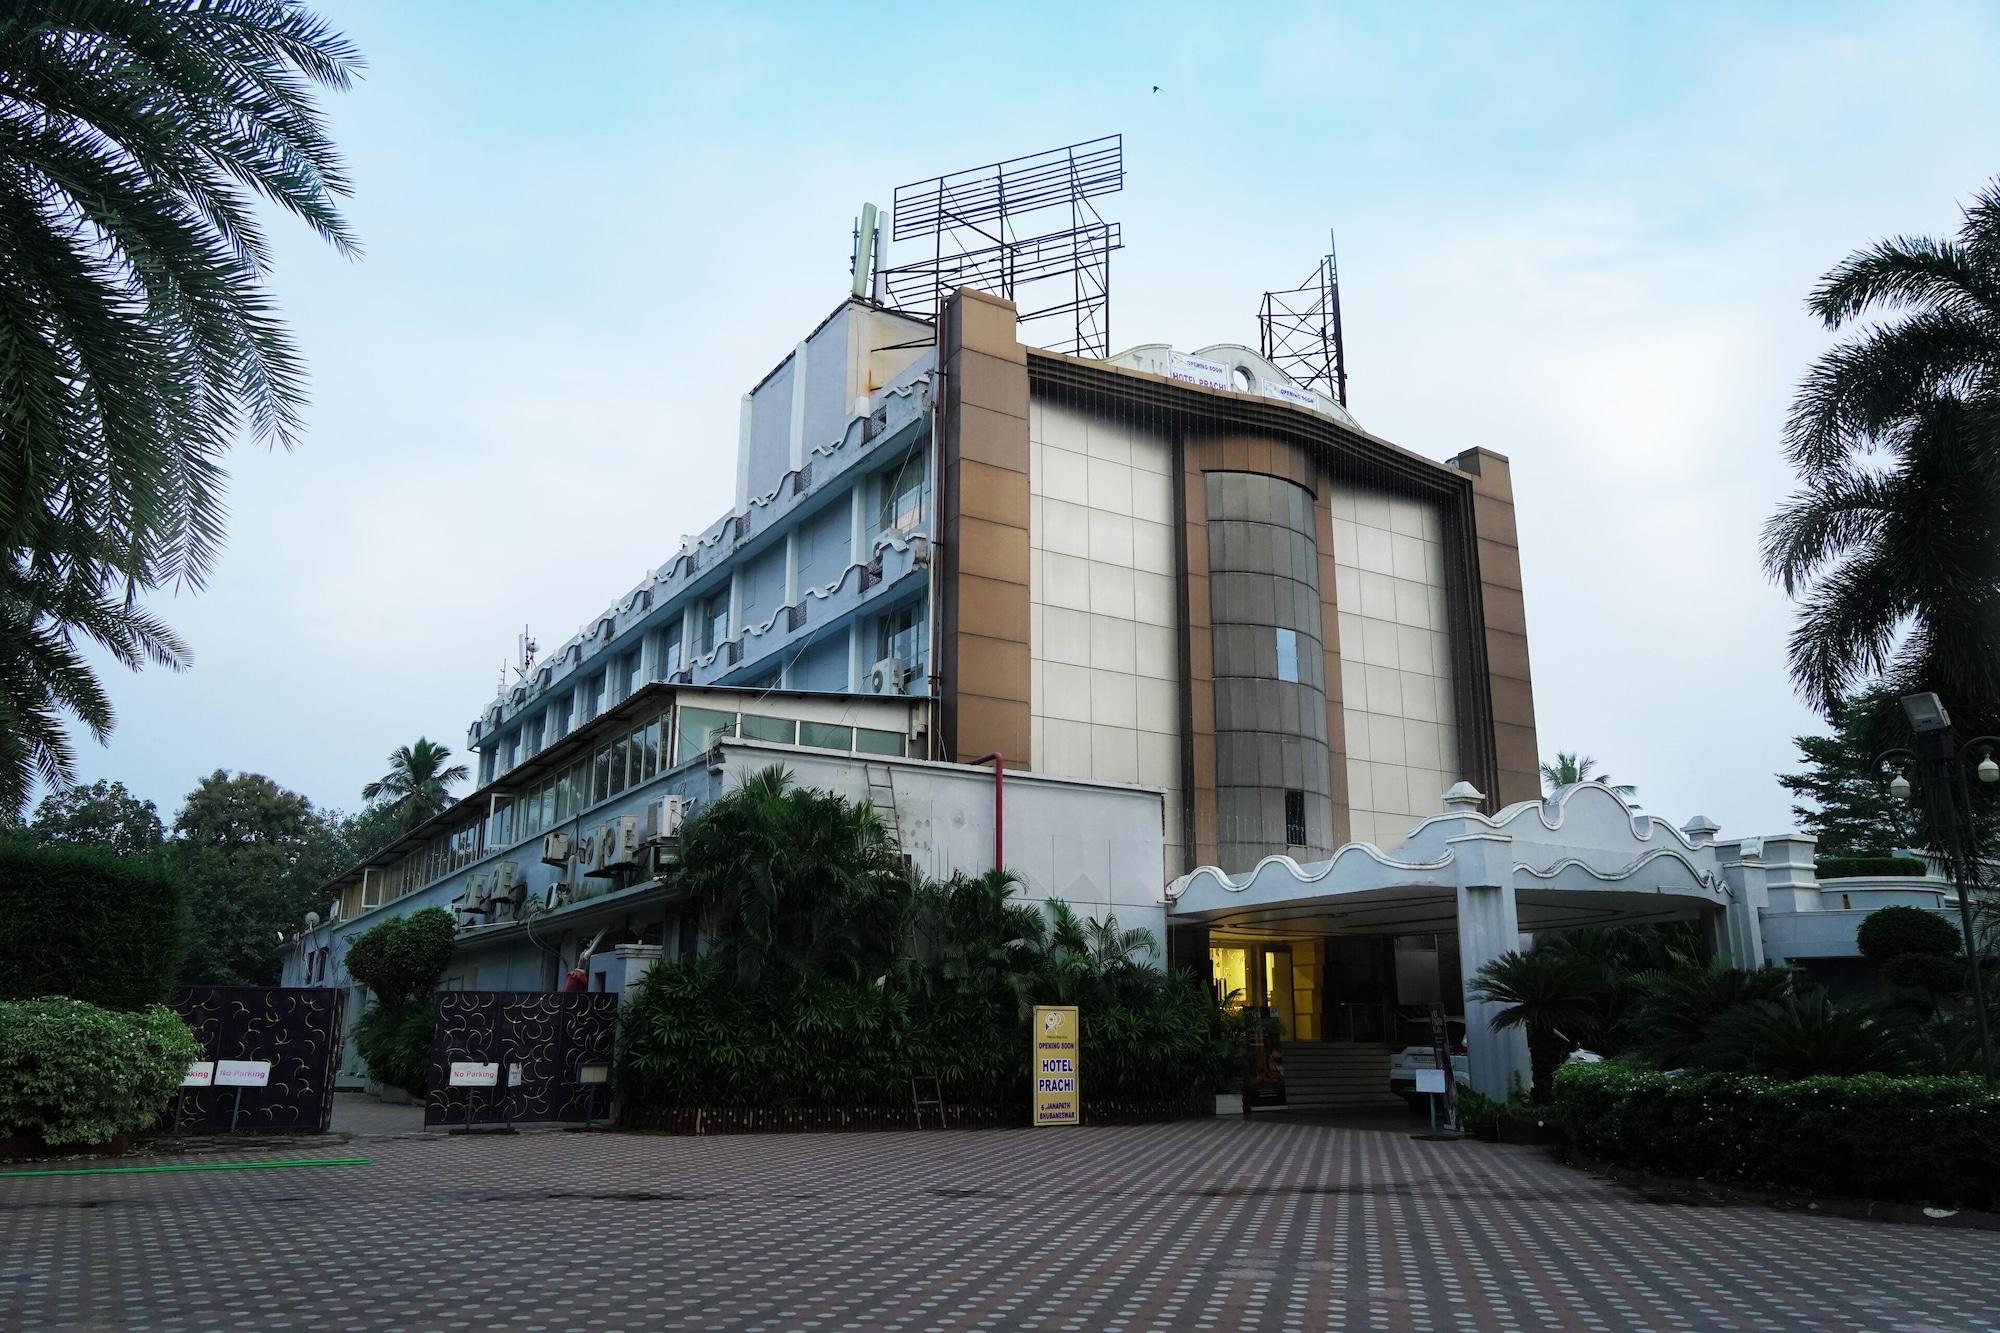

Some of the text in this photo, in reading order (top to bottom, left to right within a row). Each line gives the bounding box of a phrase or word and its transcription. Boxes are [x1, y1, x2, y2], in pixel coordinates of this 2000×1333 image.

[1187, 360, 1223, 374] OPENING SOON
[1173, 372, 1195, 384] HOTEL
[1042, 1060, 1073, 1072] HOTEL
[233, 1070, 265, 1079] Parking
[466, 1071, 495, 1079] Parking
[1039, 1079, 1074, 1091] PRACHI
